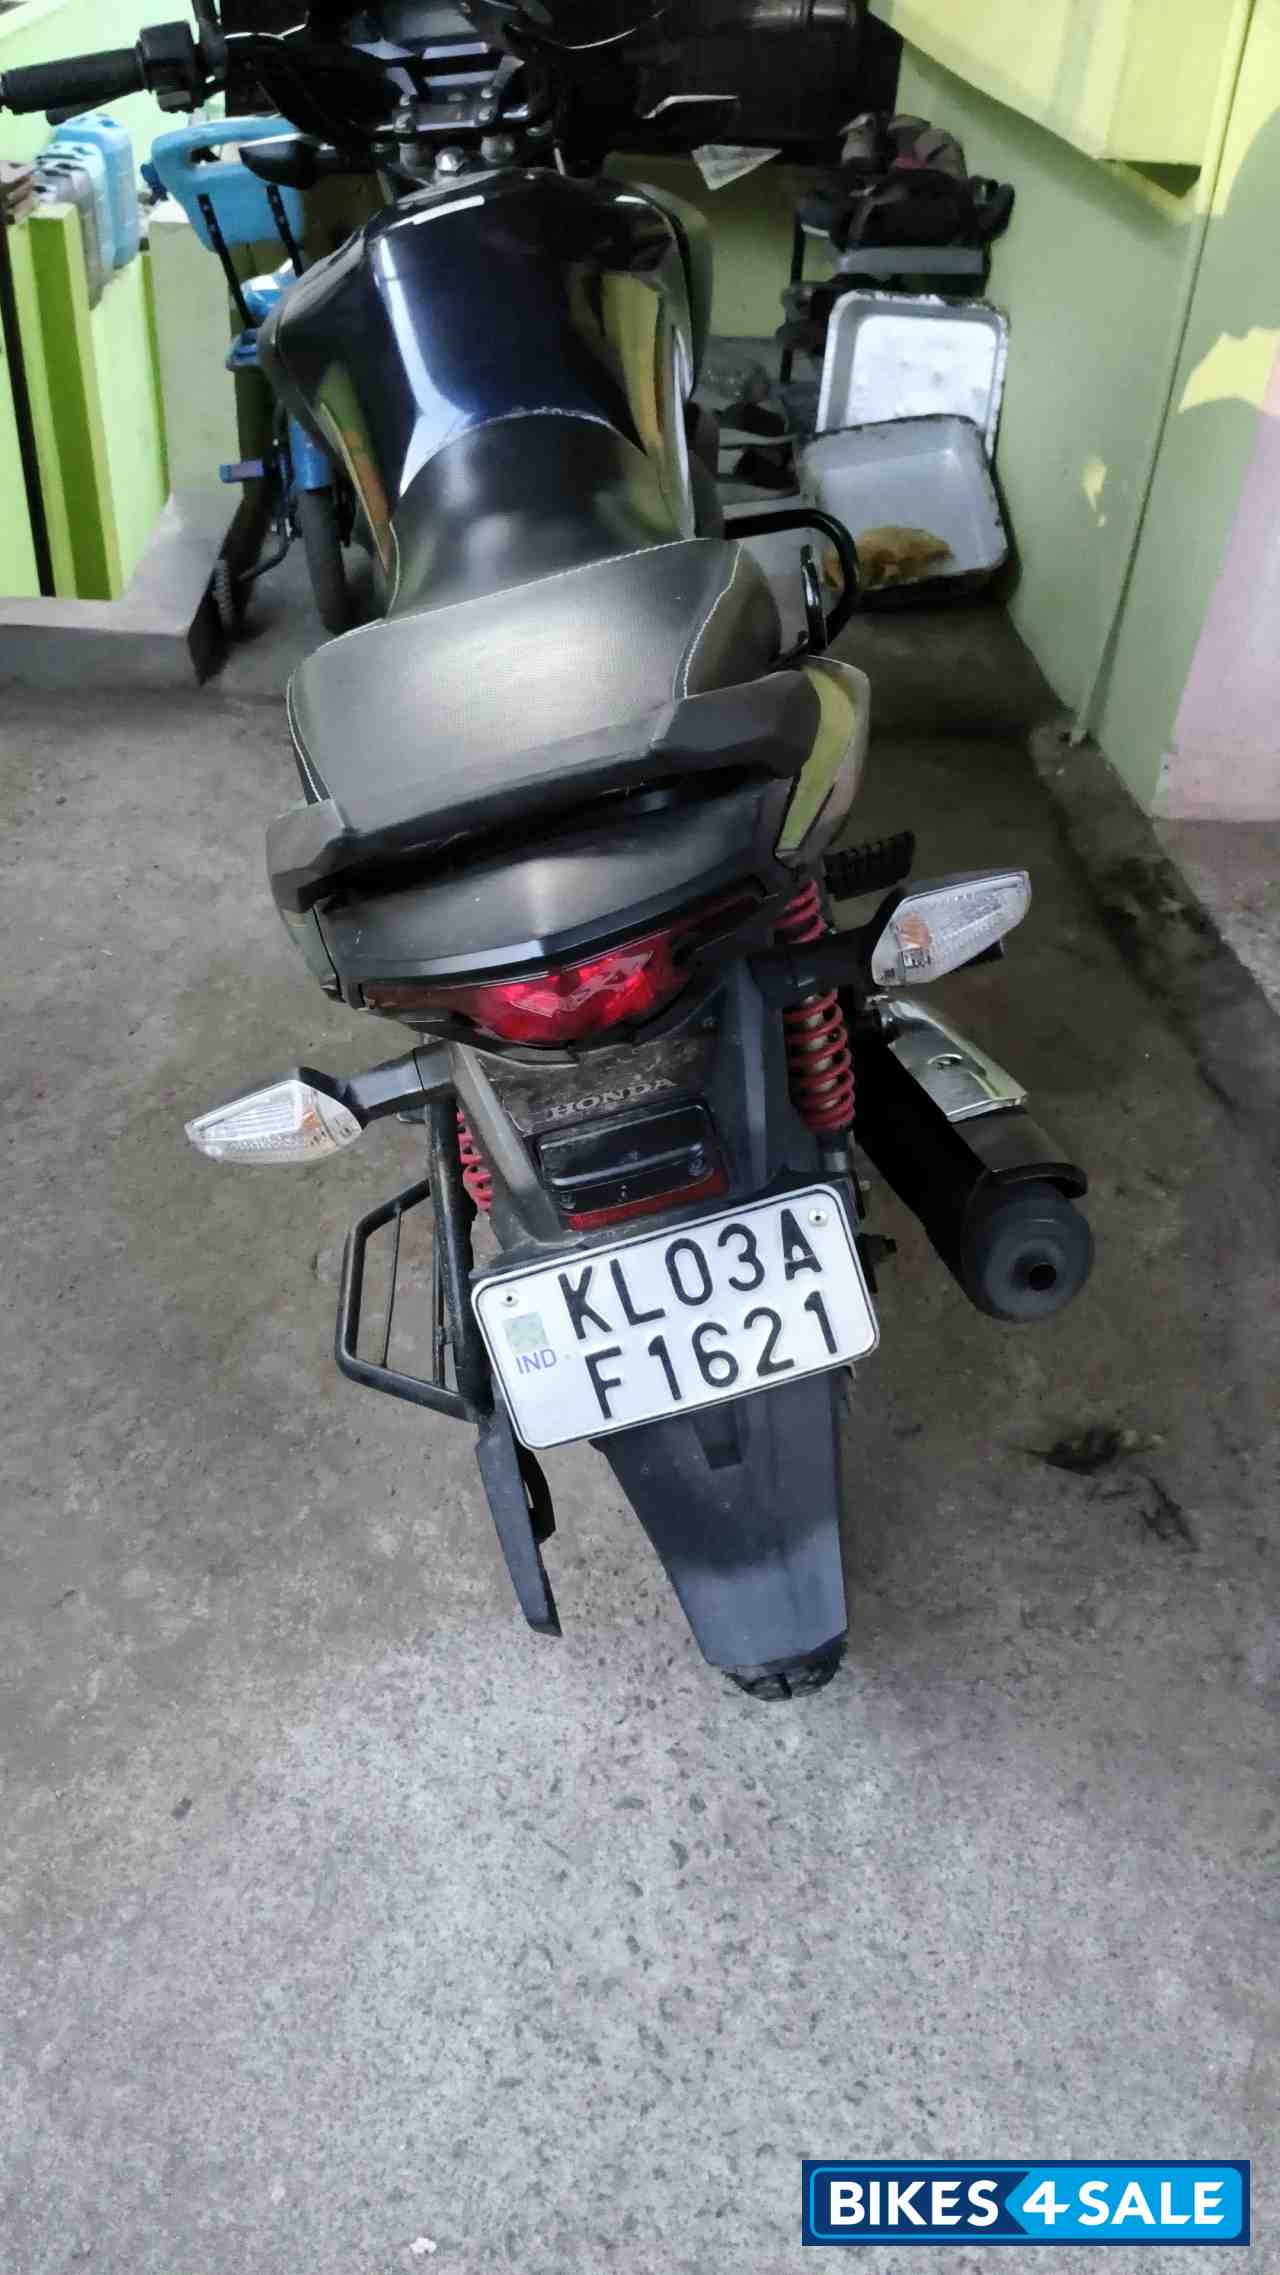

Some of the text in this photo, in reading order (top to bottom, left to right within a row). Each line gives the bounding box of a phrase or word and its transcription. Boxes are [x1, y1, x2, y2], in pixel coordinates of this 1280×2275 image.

[547, 1078, 677, 1120] HONDA
[558, 1208, 823, 1341] KL03A
[515, 1348, 558, 1375] IND
[584, 1290, 838, 1419] F1621
